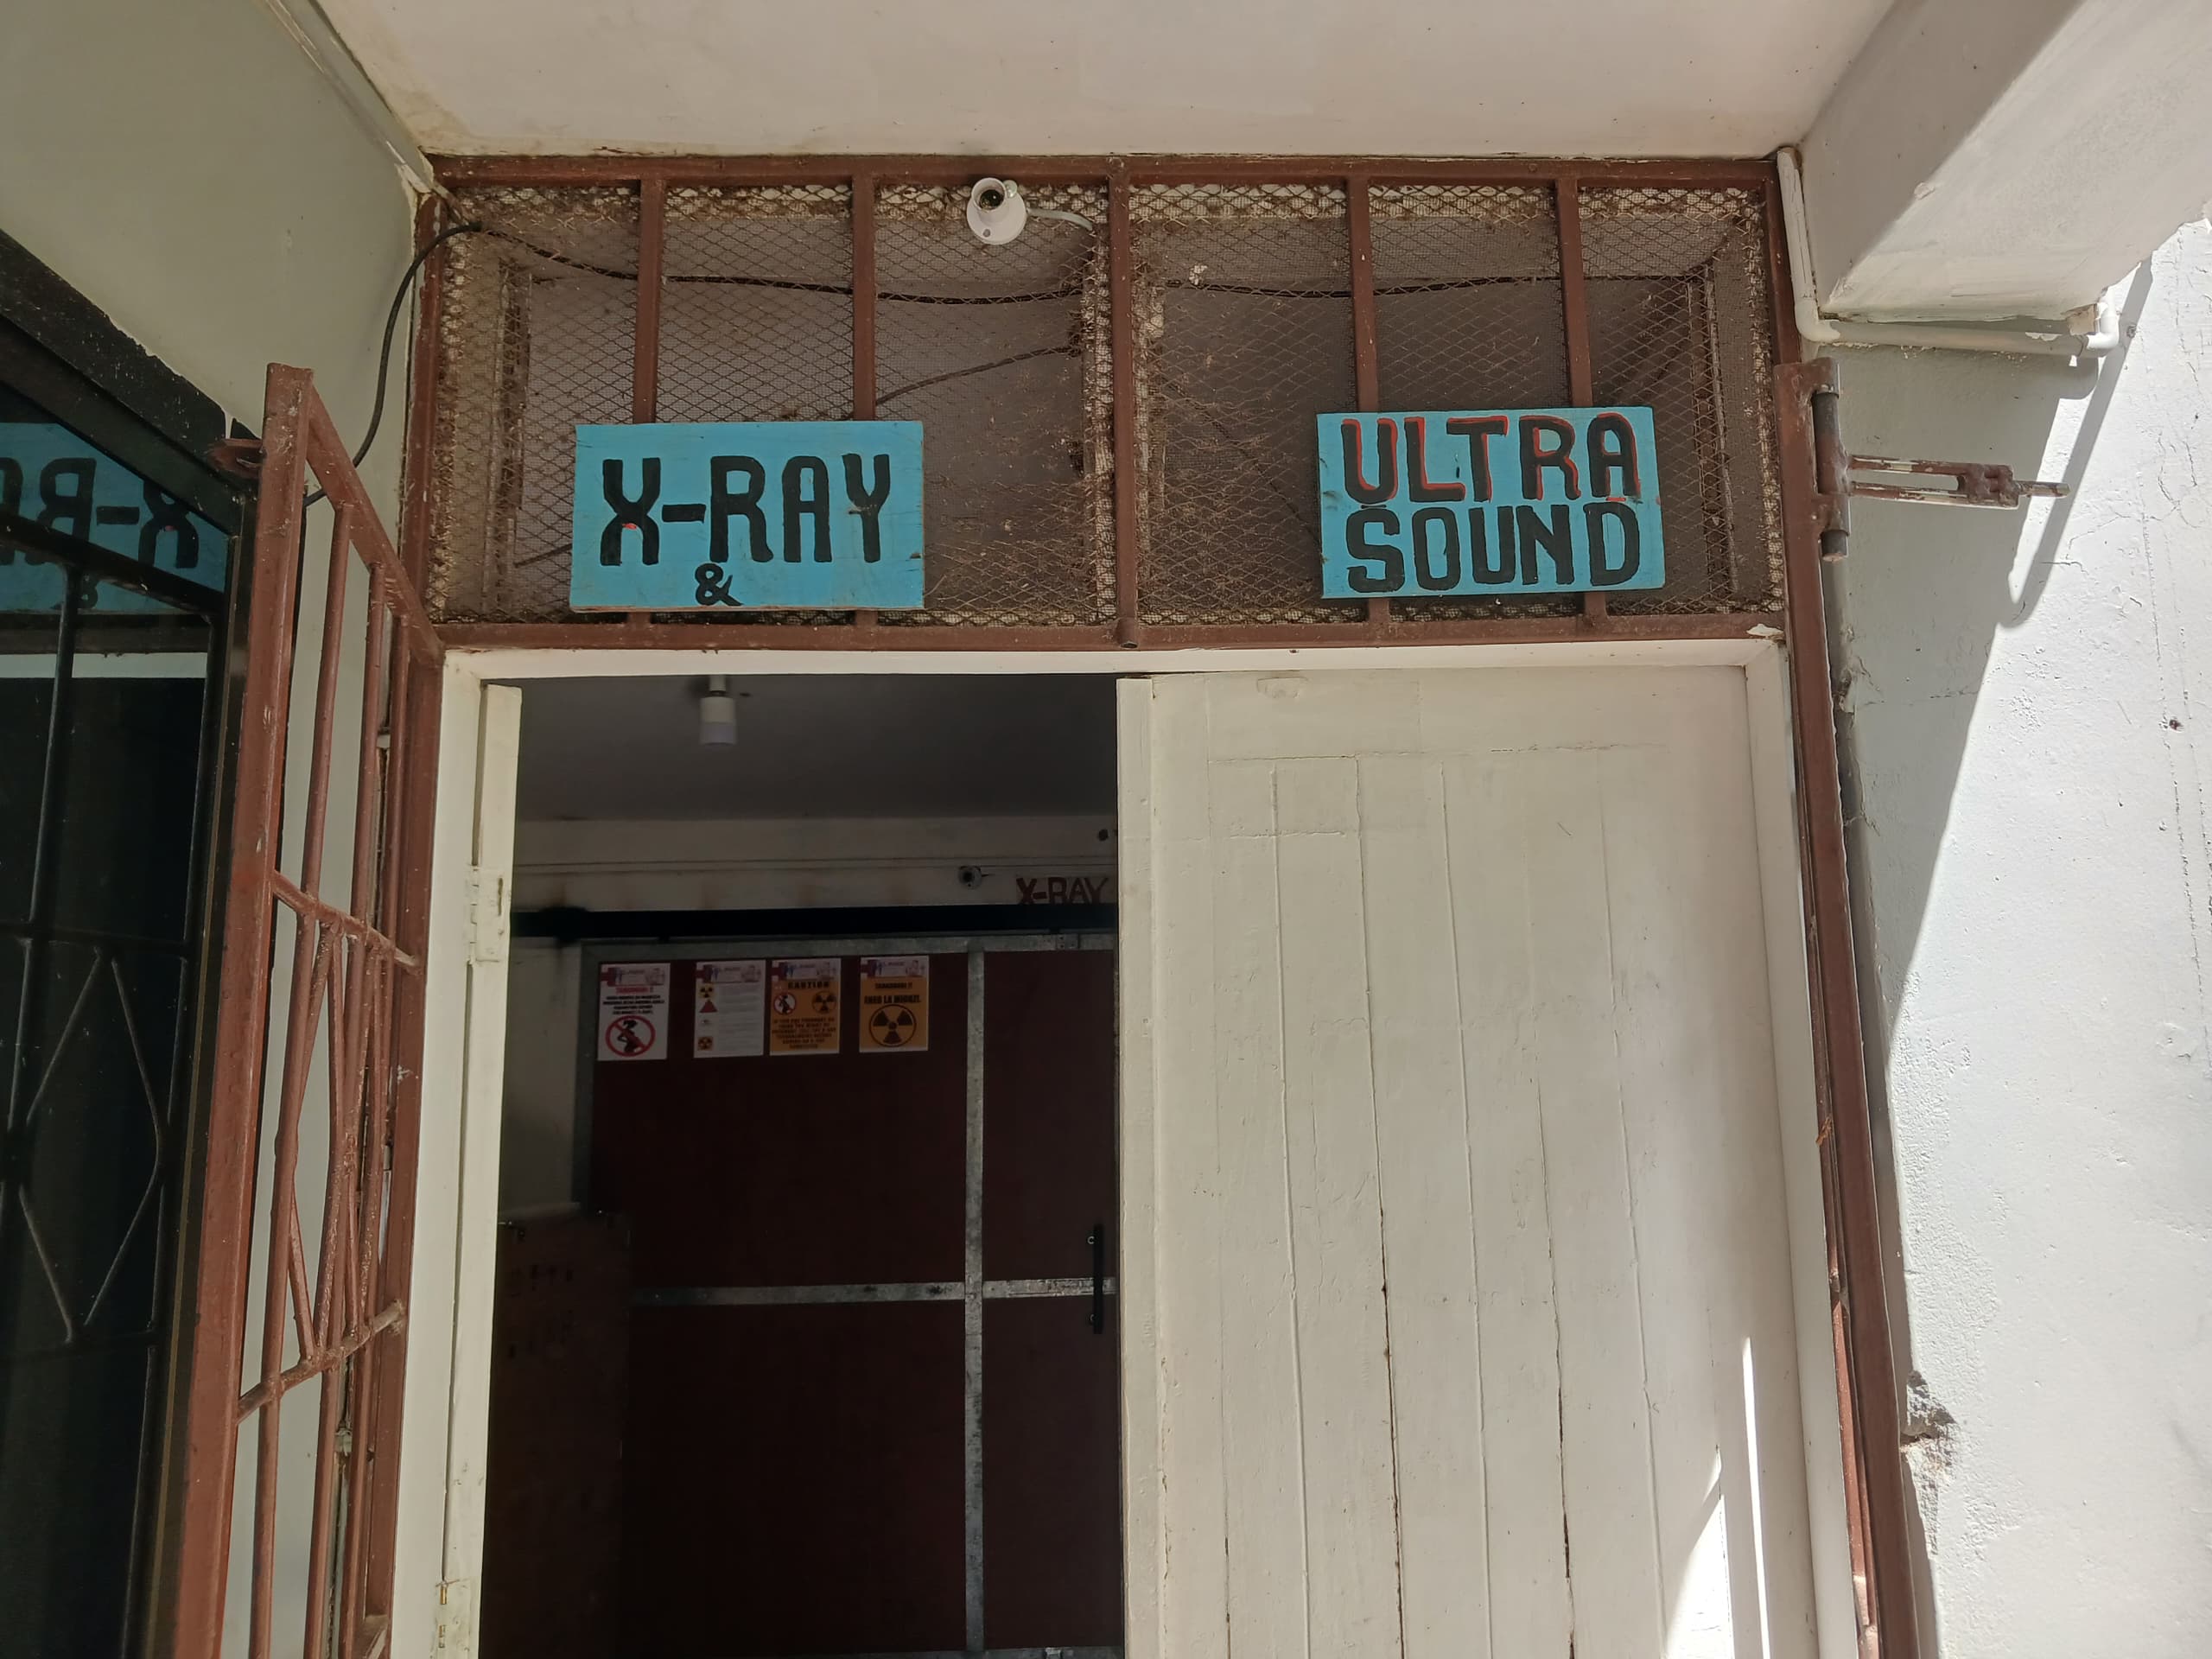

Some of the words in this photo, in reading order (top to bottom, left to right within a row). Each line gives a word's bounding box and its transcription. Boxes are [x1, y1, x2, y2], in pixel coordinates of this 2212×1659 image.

[1341, 412, 1641, 504] ULTRA
[600, 454, 891, 566] X-RAY
[1346, 502, 1640, 593] SOUND
[695, 563, 743, 607] &
[1016, 876, 1109, 906] X-RAY
